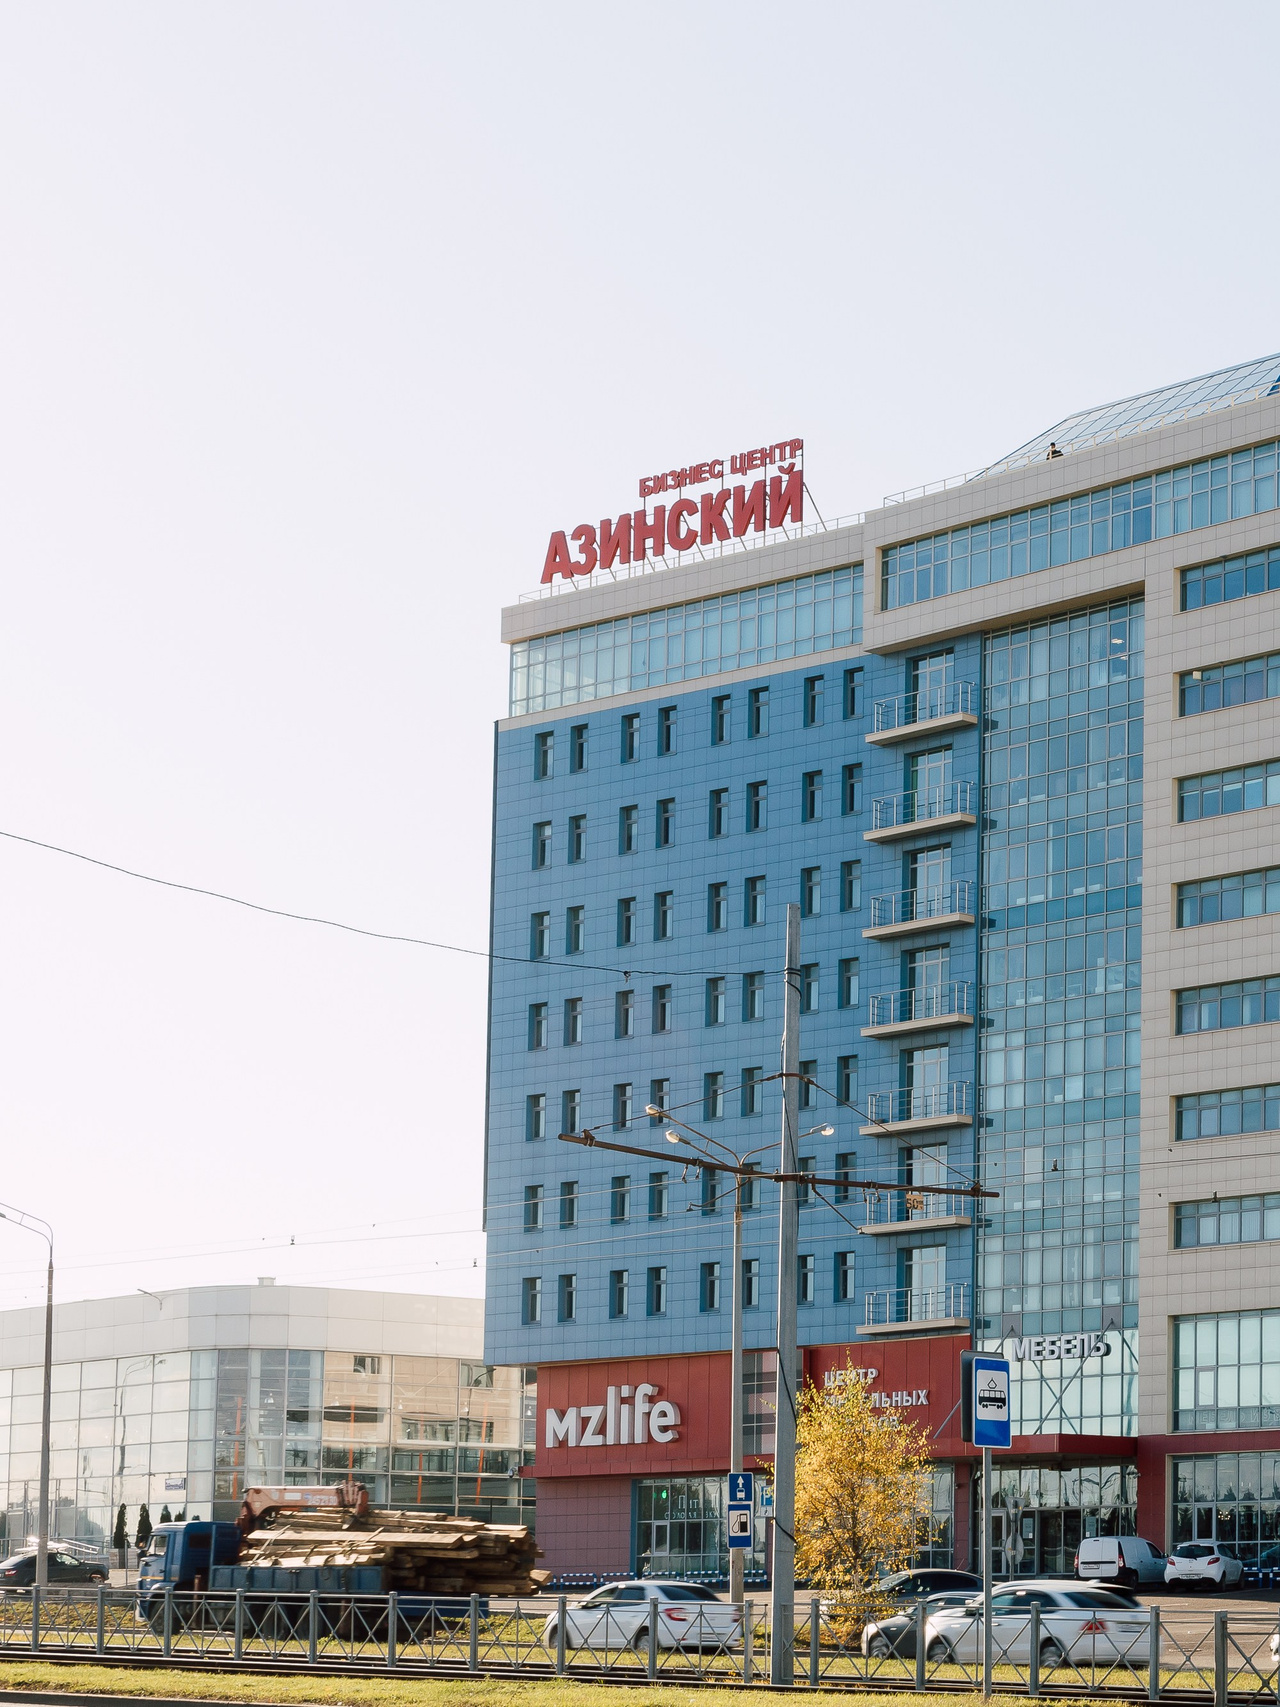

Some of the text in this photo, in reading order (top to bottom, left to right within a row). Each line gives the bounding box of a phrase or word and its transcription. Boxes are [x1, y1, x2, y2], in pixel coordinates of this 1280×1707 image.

[639, 438, 803, 498] БИЗНЕС ЦЕНТР
[540, 462, 804, 584] АЗИНСКИЙ
[1012, 1333, 1110, 1362] МЕБЕЛЬ
[824, 1389, 929, 1408] МЕЛЬНЫХ
